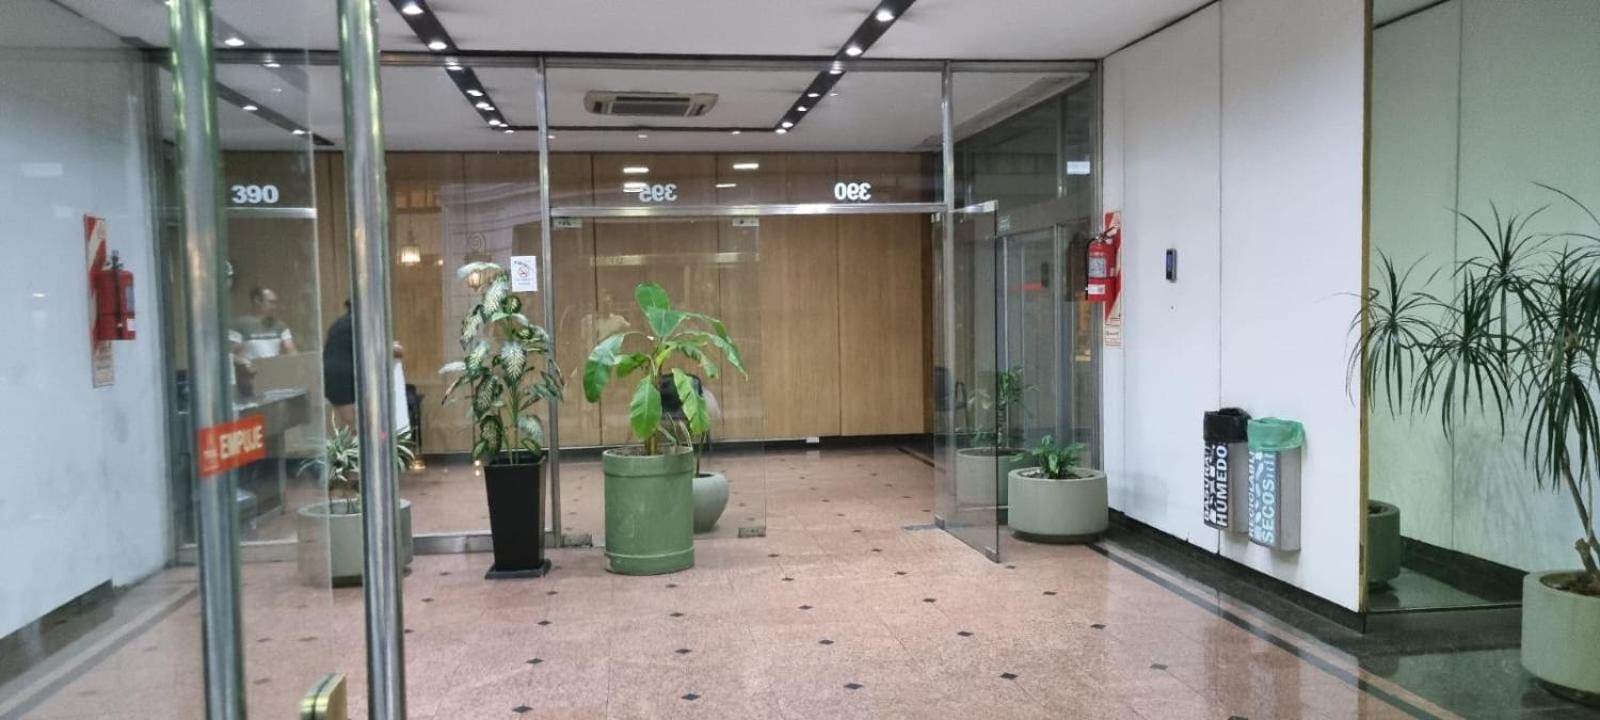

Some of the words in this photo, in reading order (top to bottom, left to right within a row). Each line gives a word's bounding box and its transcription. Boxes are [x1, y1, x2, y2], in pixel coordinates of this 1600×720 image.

[231, 184, 279, 204] 390
[220, 425, 264, 460] EMPUJE
[1214, 442, 1228, 527] HÚMEDO
[1262, 479, 1275, 544] SECOS
